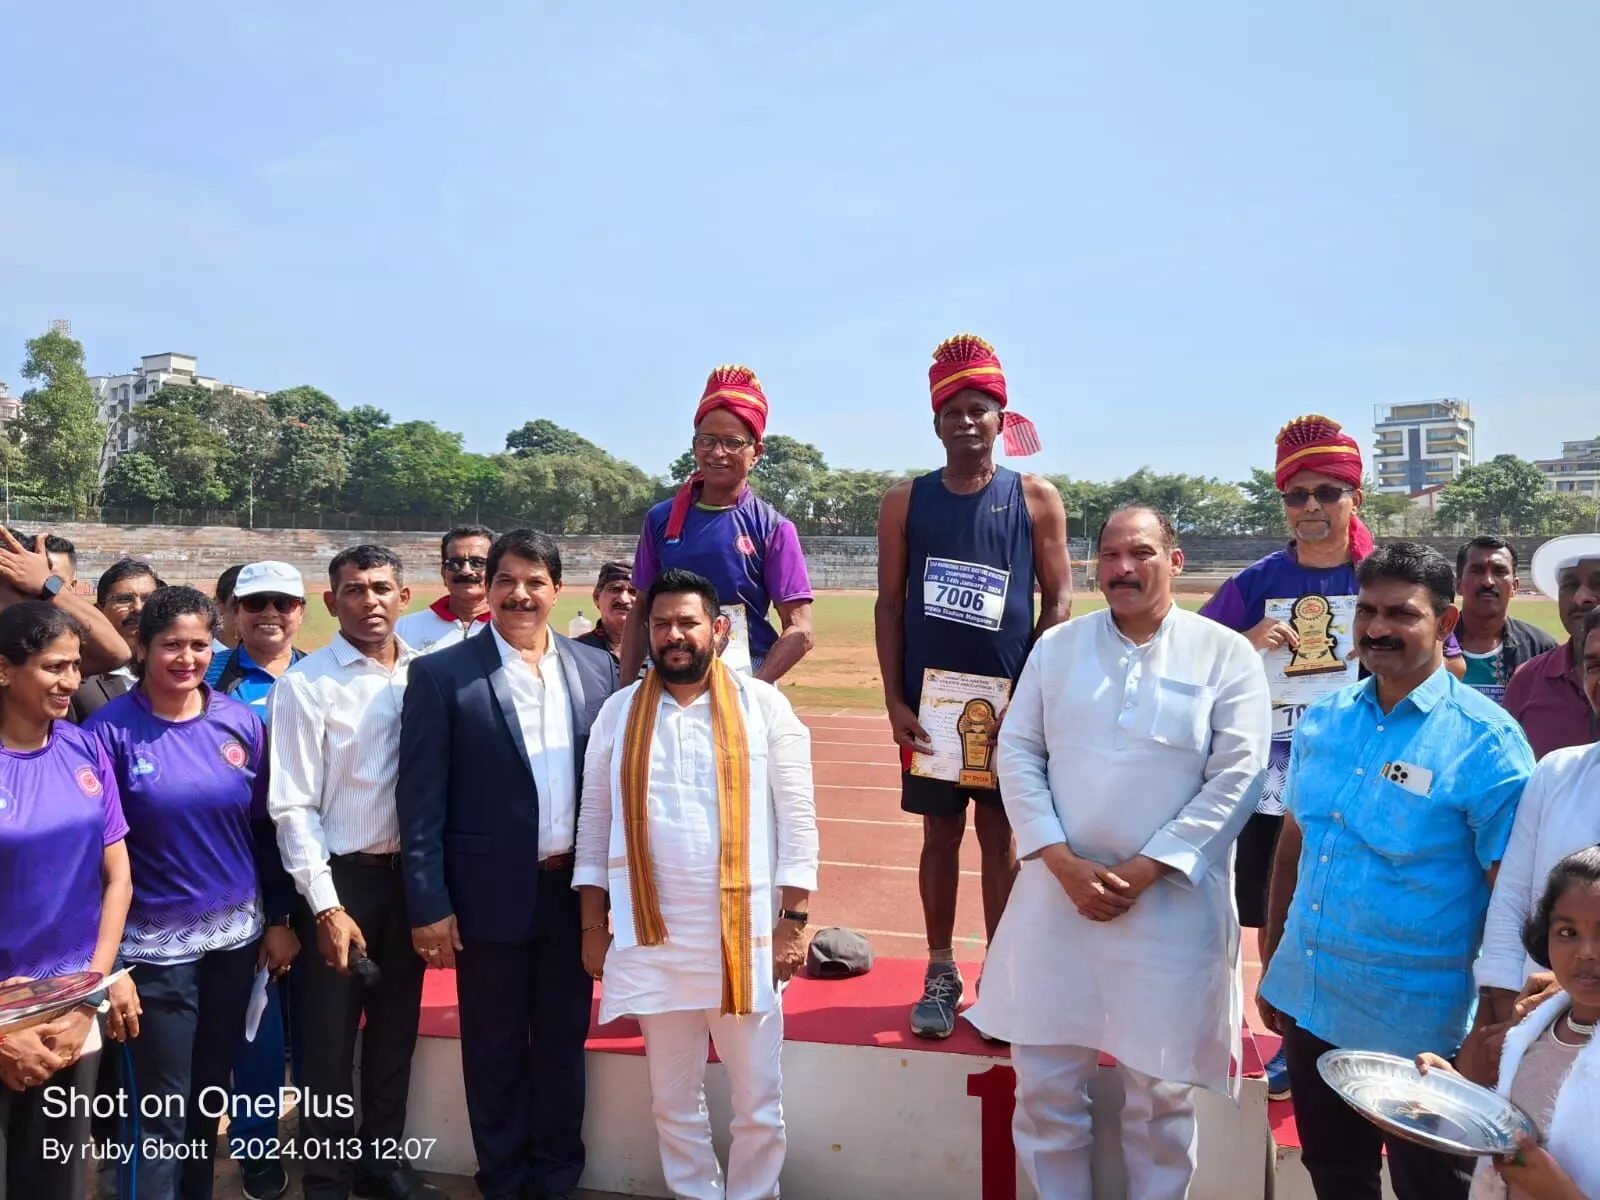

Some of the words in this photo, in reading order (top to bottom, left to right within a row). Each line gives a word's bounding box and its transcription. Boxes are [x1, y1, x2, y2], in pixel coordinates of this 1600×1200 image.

[936, 585, 985, 611] 7006
[960, 580, 984, 590] January
[967, 1064, 1017, 1200] 1
